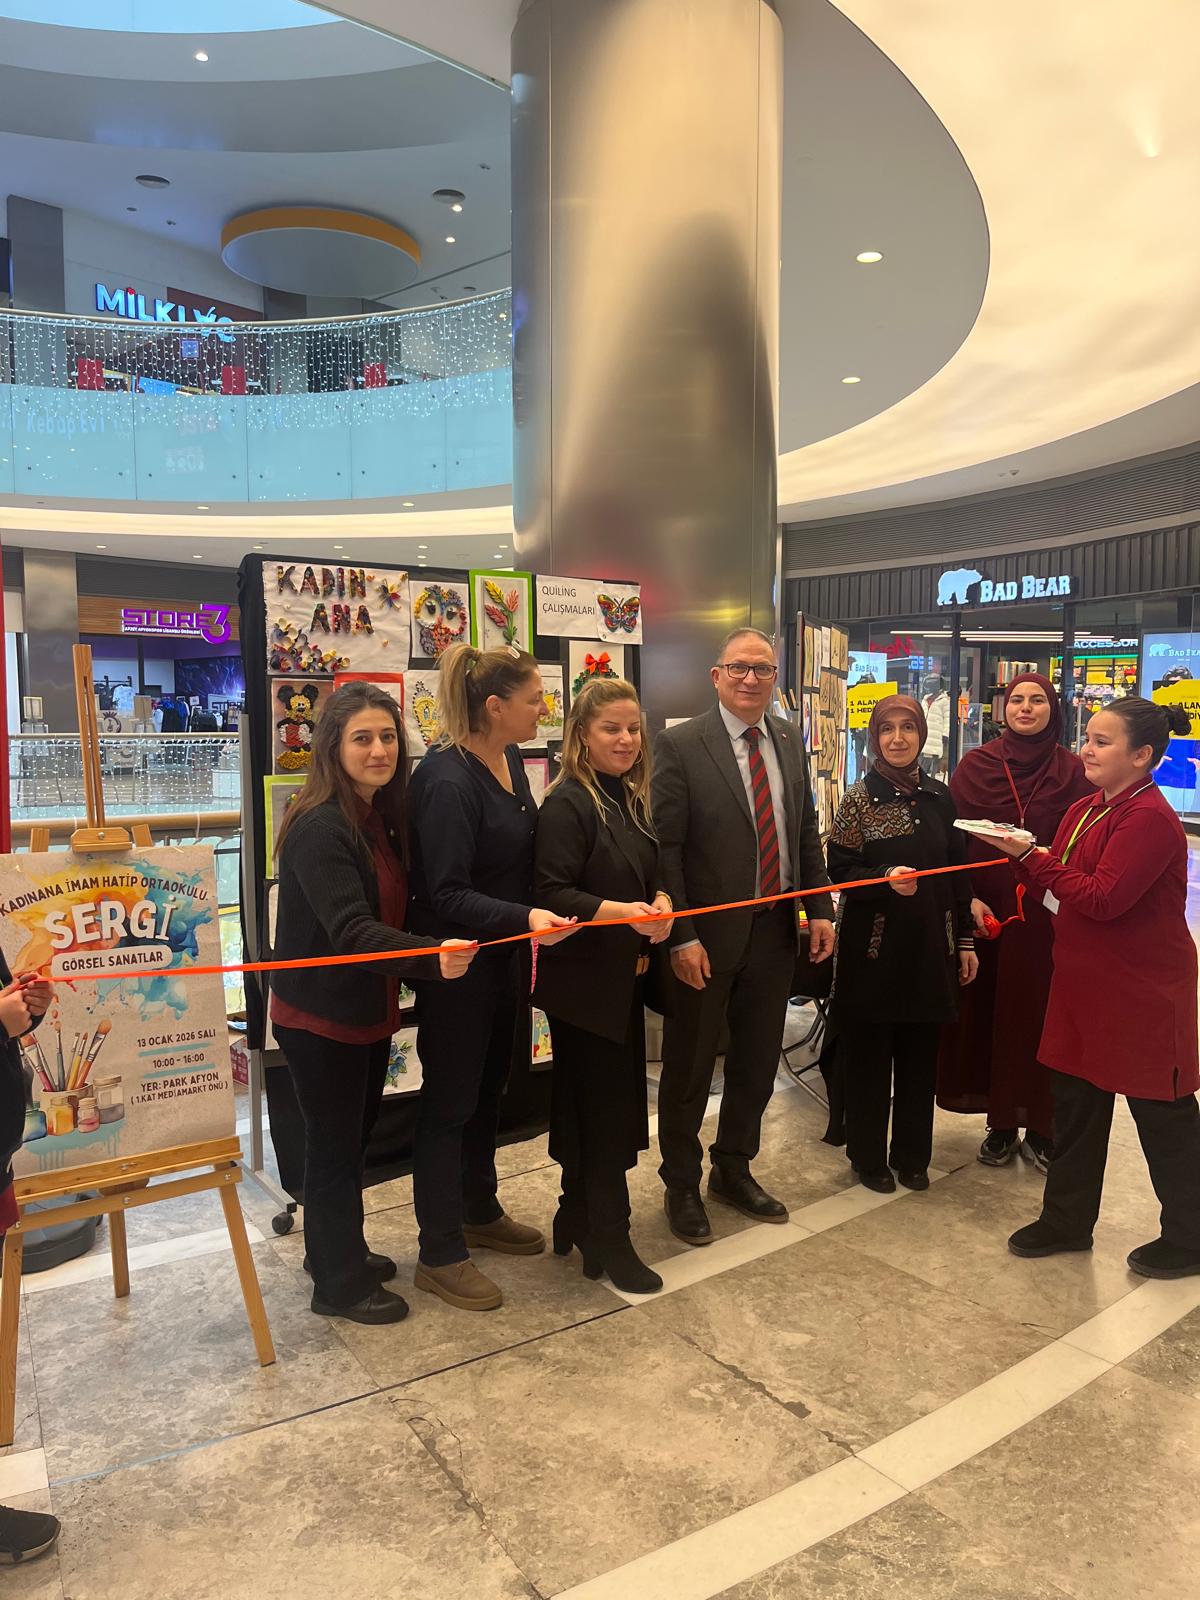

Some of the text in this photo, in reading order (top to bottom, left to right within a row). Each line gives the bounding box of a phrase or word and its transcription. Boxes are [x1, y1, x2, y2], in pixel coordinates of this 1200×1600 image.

[277, 566, 366, 597] KADIN
[980, 575, 1070, 603] BAD BEAR
[310, 603, 374, 634] ANA
[542, 603, 595, 615] ÇALIŞMALARI
[0, 884, 64, 917] KADINANA
[65, 878, 99, 893] İMAM
[102, 873, 138, 888] HATİP
[45, 894, 177, 949] SERGİ
[62, 951, 164, 972] GÖRSEL SANATLAR
[137, 1028, 217, 1048] 13 OCAK 2026 SALI
[153, 1057, 175, 1069] 10:00
[183, 1053, 205, 1064] 16:00
[141, 1071, 219, 1092] YER: PARK AFYON
